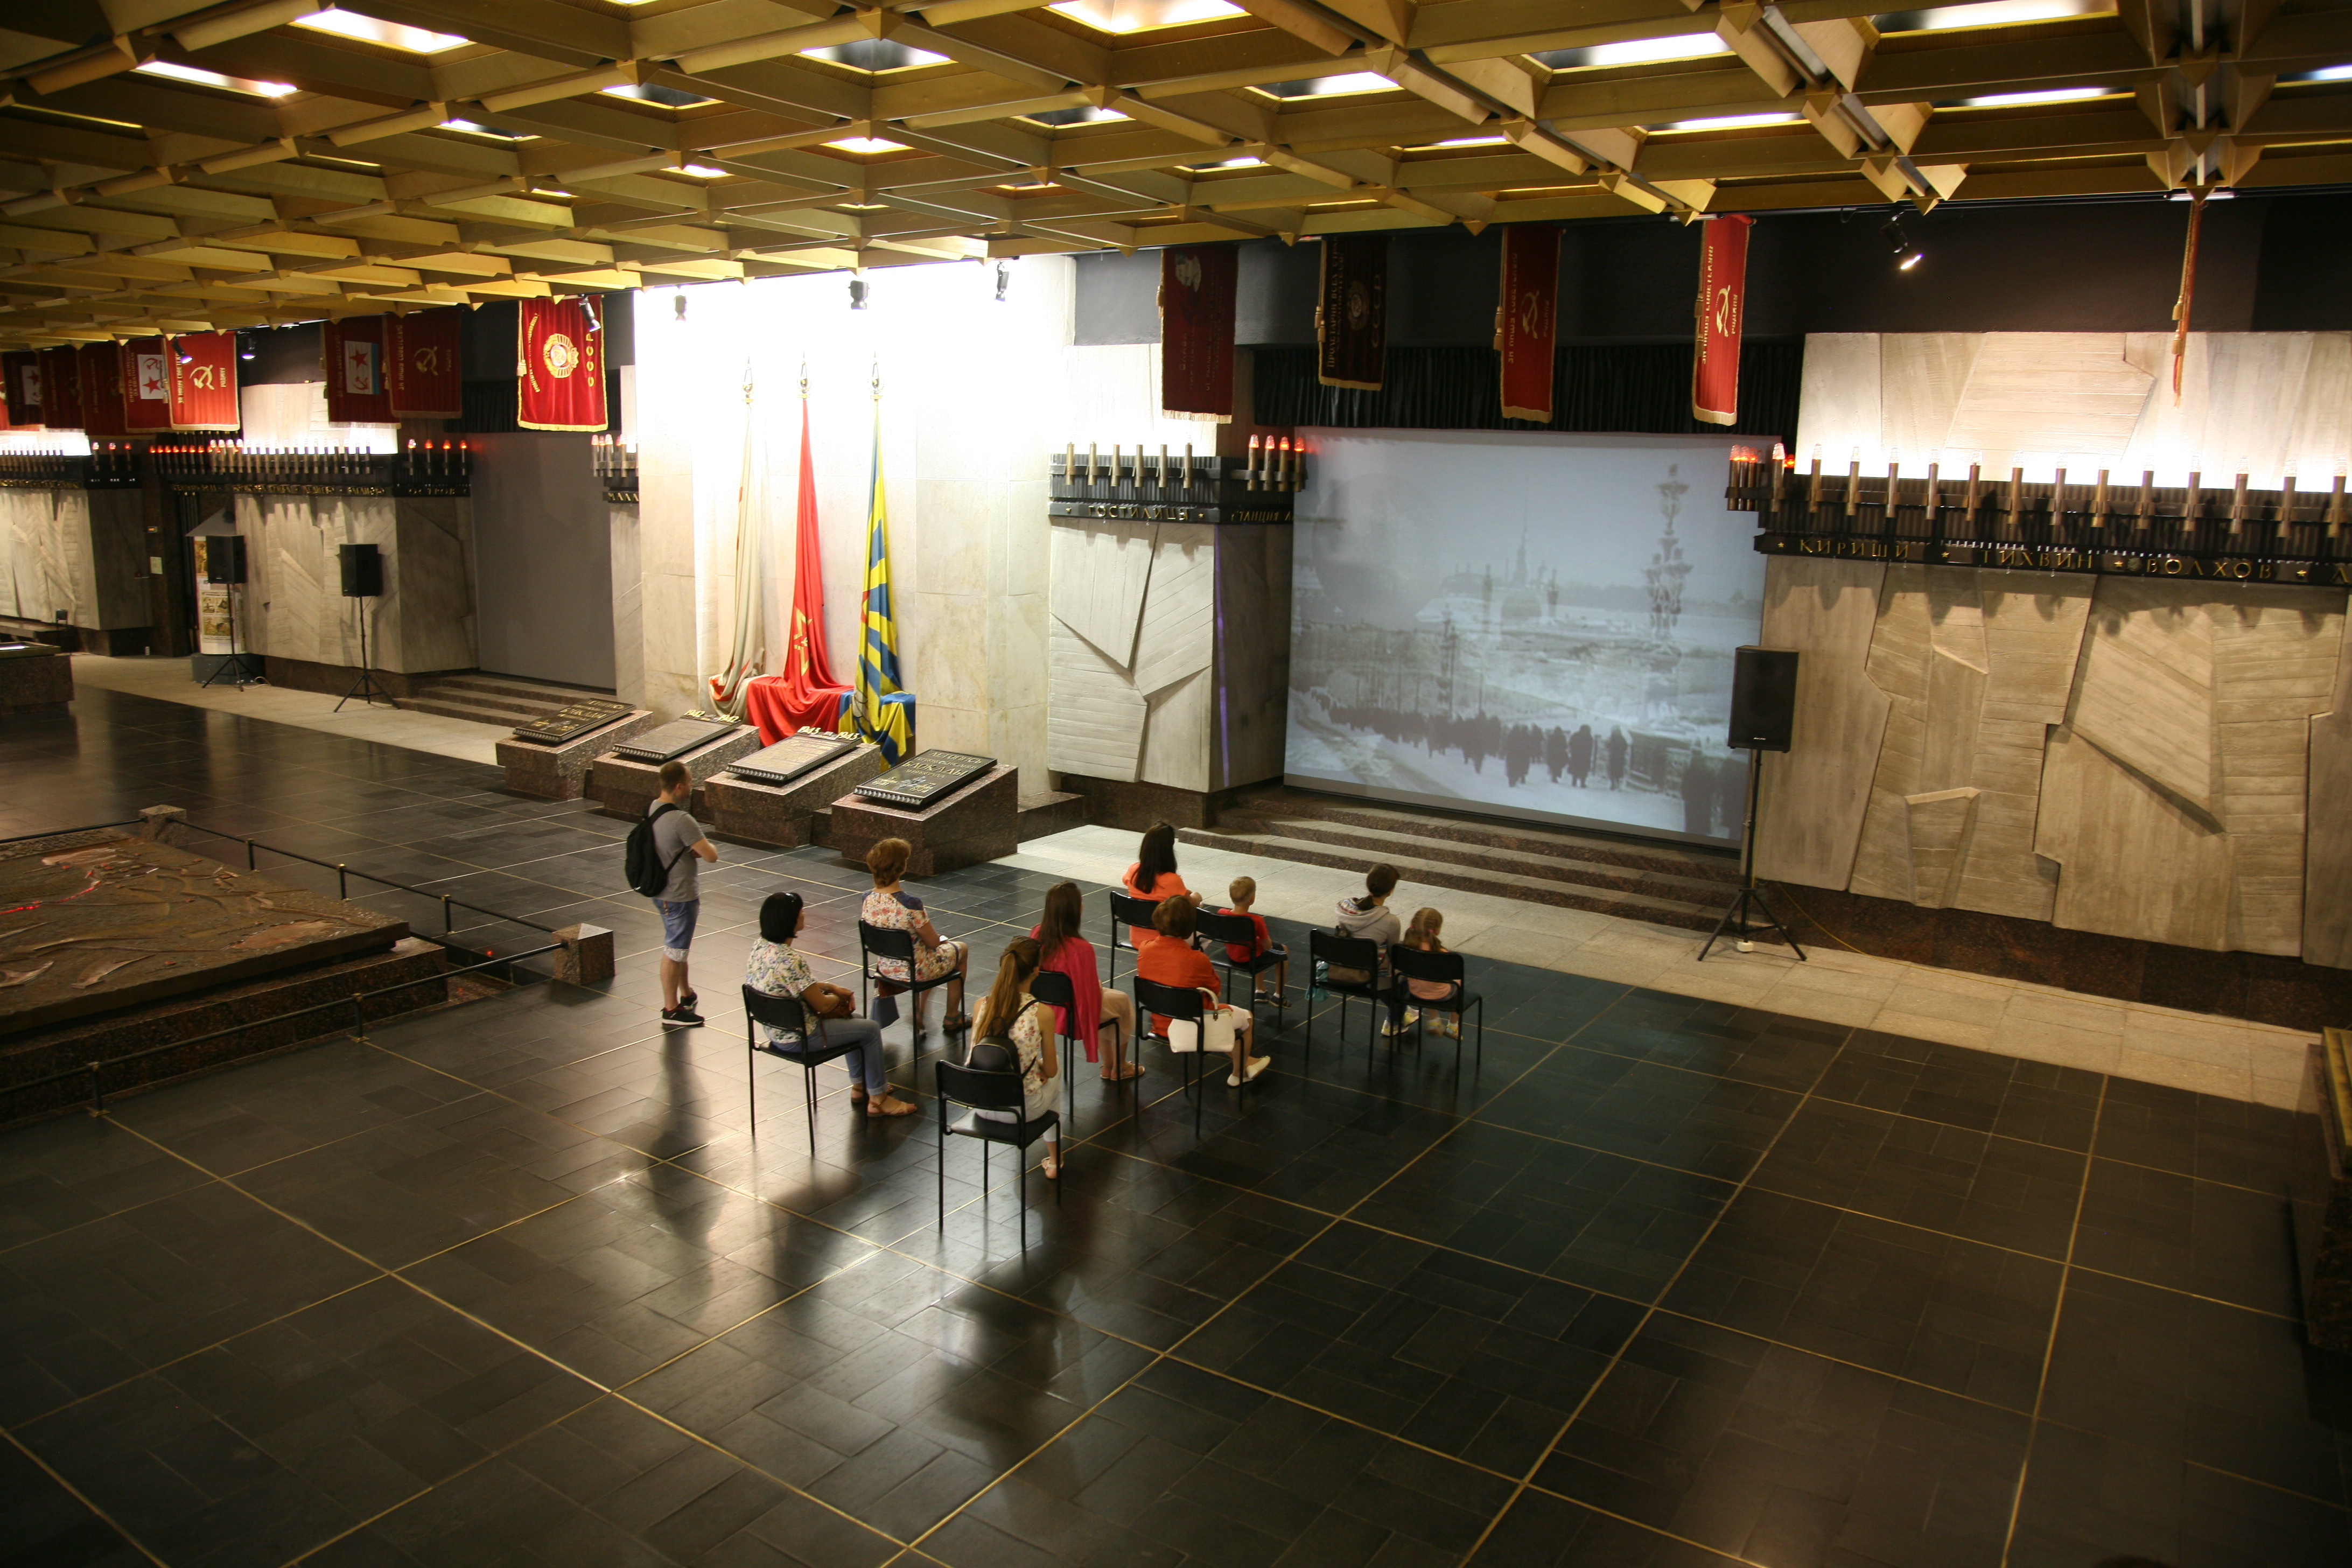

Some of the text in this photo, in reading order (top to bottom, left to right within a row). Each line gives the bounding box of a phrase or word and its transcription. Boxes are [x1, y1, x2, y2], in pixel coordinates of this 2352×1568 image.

[1330, 274, 1338, 299] ВСЕХ
[1371, 274, 1382, 348] СССР
[1327, 304, 1338, 368] ПРОЛЕТАРИИ
[585, 333, 595, 387] СССР
[1508, 351, 1514, 363] ЗА
[1088, 505, 1189, 521] ГОСТИЛИЦЫ
[1231, 510, 1279, 523] СТАНЦИЯ
[1800, 539, 1909, 558] КИРИШИ
[1981, 550, 2093, 569] ТИХВИН
[2146, 558, 2271, 578] ВОЛХОВ
[797, 725, 822, 734] 1943
[836, 731, 860, 740] 1943
[929, 752, 982, 764] ЛЕТОПИСЬ
[902, 761, 969, 776] БЛОКАДЫ
